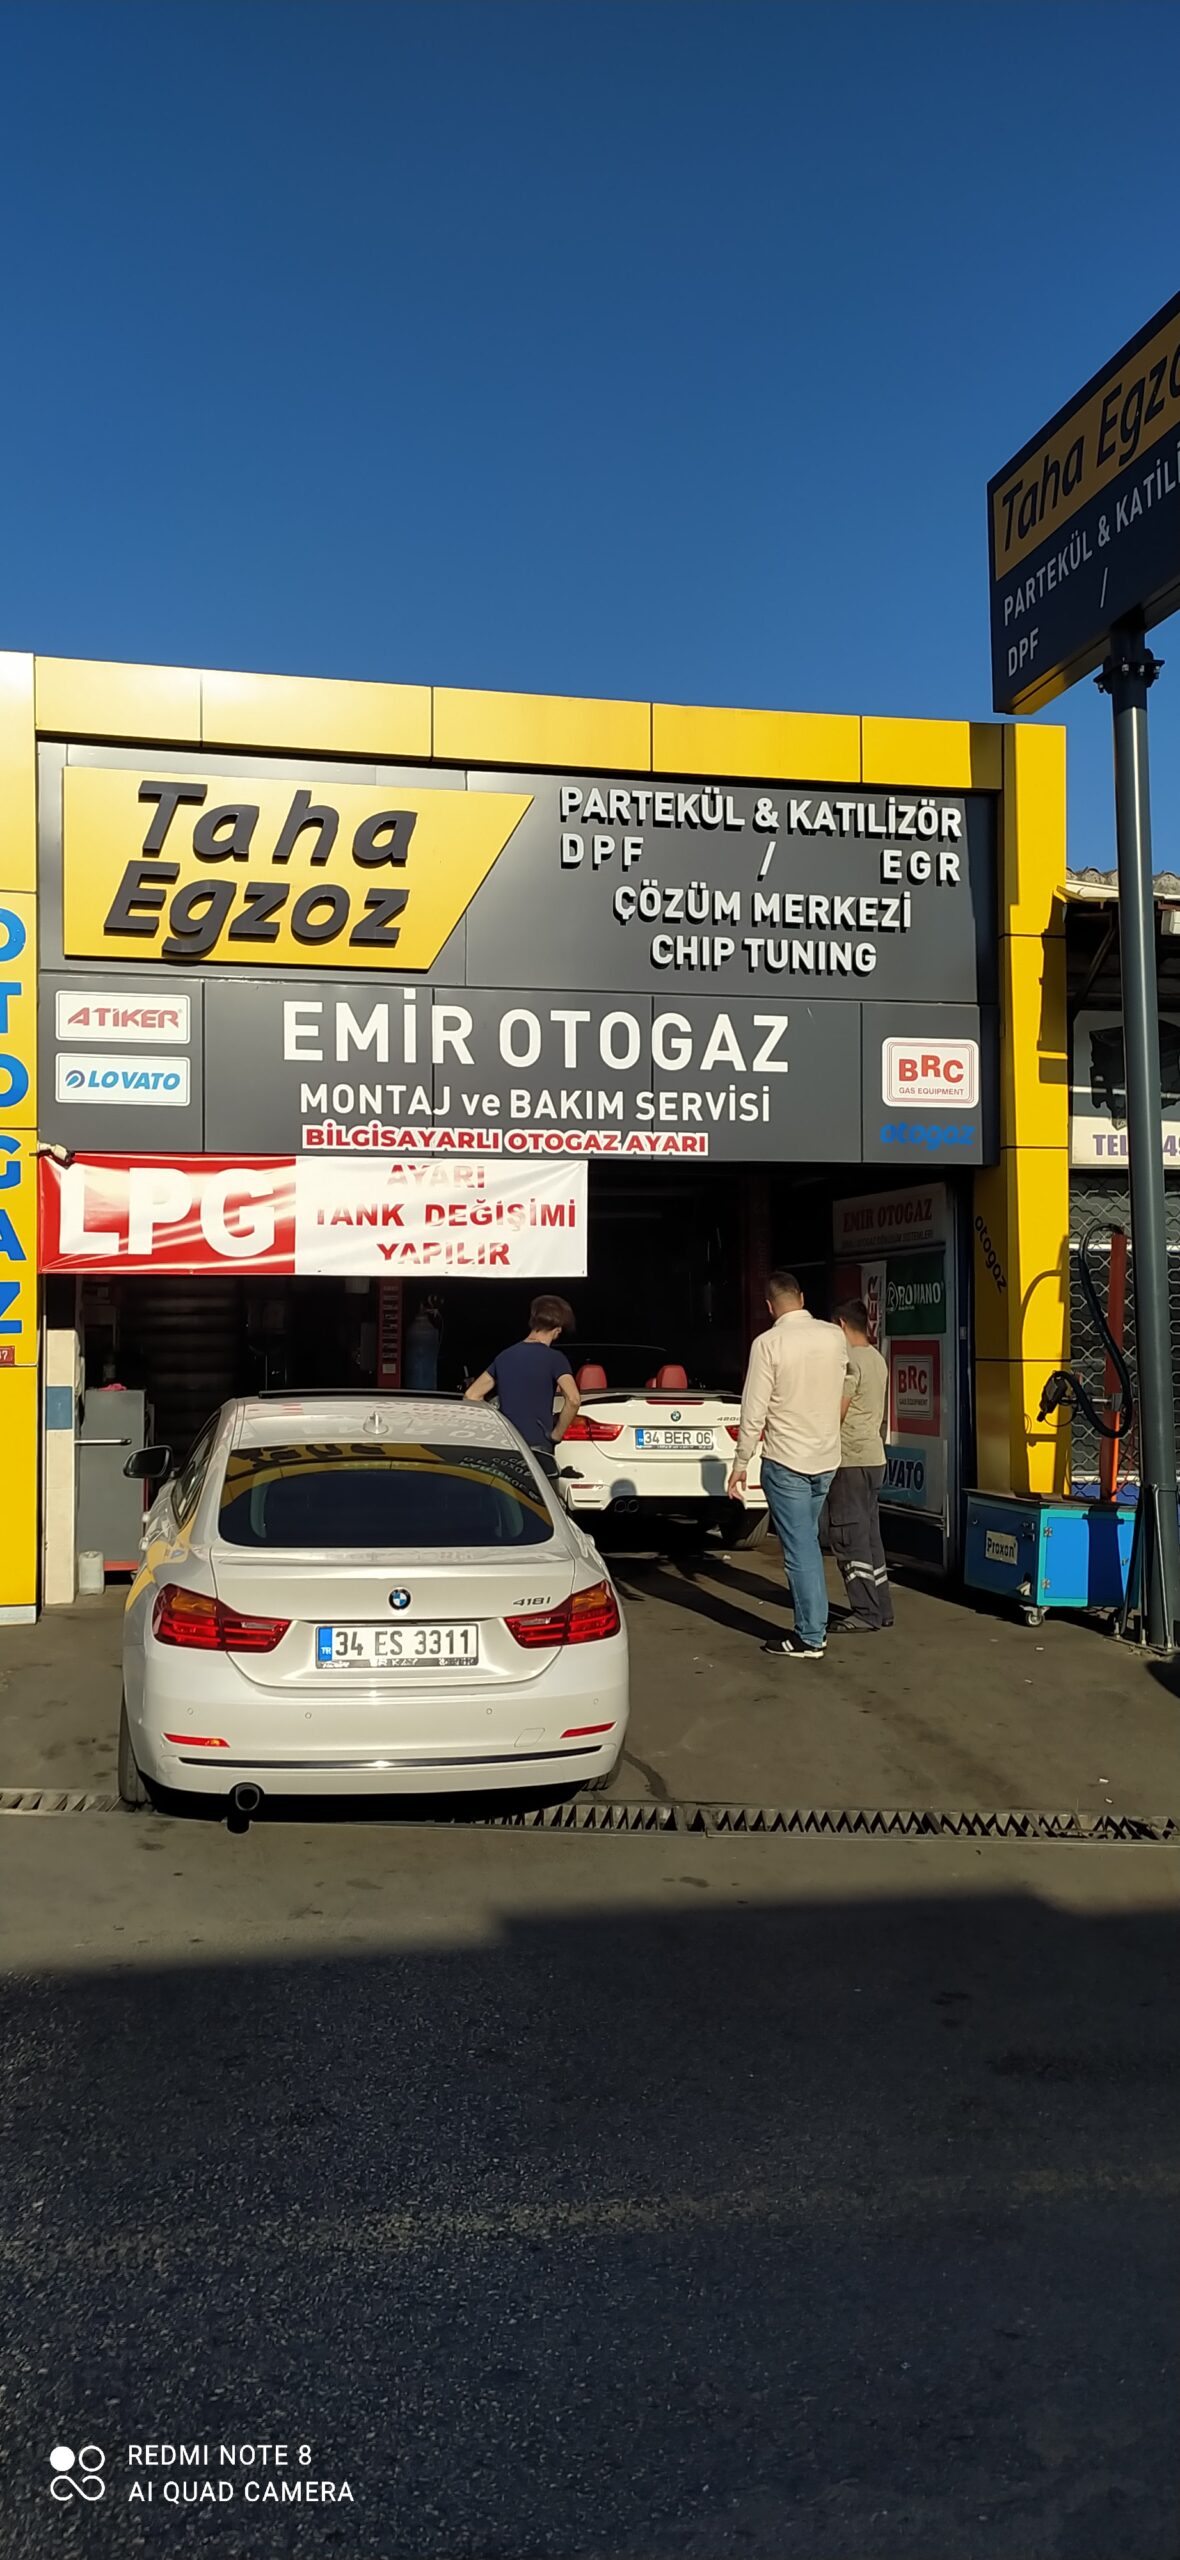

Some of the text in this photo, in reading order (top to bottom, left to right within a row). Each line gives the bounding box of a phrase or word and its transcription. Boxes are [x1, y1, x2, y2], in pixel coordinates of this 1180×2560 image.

[1002, 435, 1085, 552] Taha
[1004, 529, 1092, 627] PARTEKÜL
[1098, 515, 1111, 545] &
[1008, 627, 1039, 677] DPF
[138, 779, 418, 868] Taha
[560, 785, 962, 838] PARTEKÜL & KATILİZÖR
[103, 860, 410, 958] Egzoz
[614, 878, 912, 929] ÇÖZÜM MERKEZİ
[651, 934, 878, 974] CHIP TUNING
[282, 988, 790, 1073] EMİR OTOGAZ
[87, 1071, 181, 1091] LOVATO
[898, 1054, 964, 1083] BRC
[300, 1082, 771, 1122] MONTAJ ve BAKIM SERVİSİ
[898, 1087, 965, 1096] GAS EQUIPMENT
[305, 1121, 706, 1153] BİLGİSAYARLI OTOGAZ AYARI
[386, 1164, 485, 1189] AYARI
[58, 1165, 275, 1258] LPG
[314, 1197, 576, 1232] TANK DEĞİŞİMİ
[878, 1198, 933, 1229] OTOGAZ
[376, 1242, 511, 1265] YAPILIR
[974, 1215, 1007, 1293] otogaz
[867, 1275, 879, 1345] KER
[898, 1365, 927, 1394] BRC
[644, 1431, 712, 1445] 34 BER 06
[321, 1629, 469, 1656] TR 34 ES 3311
